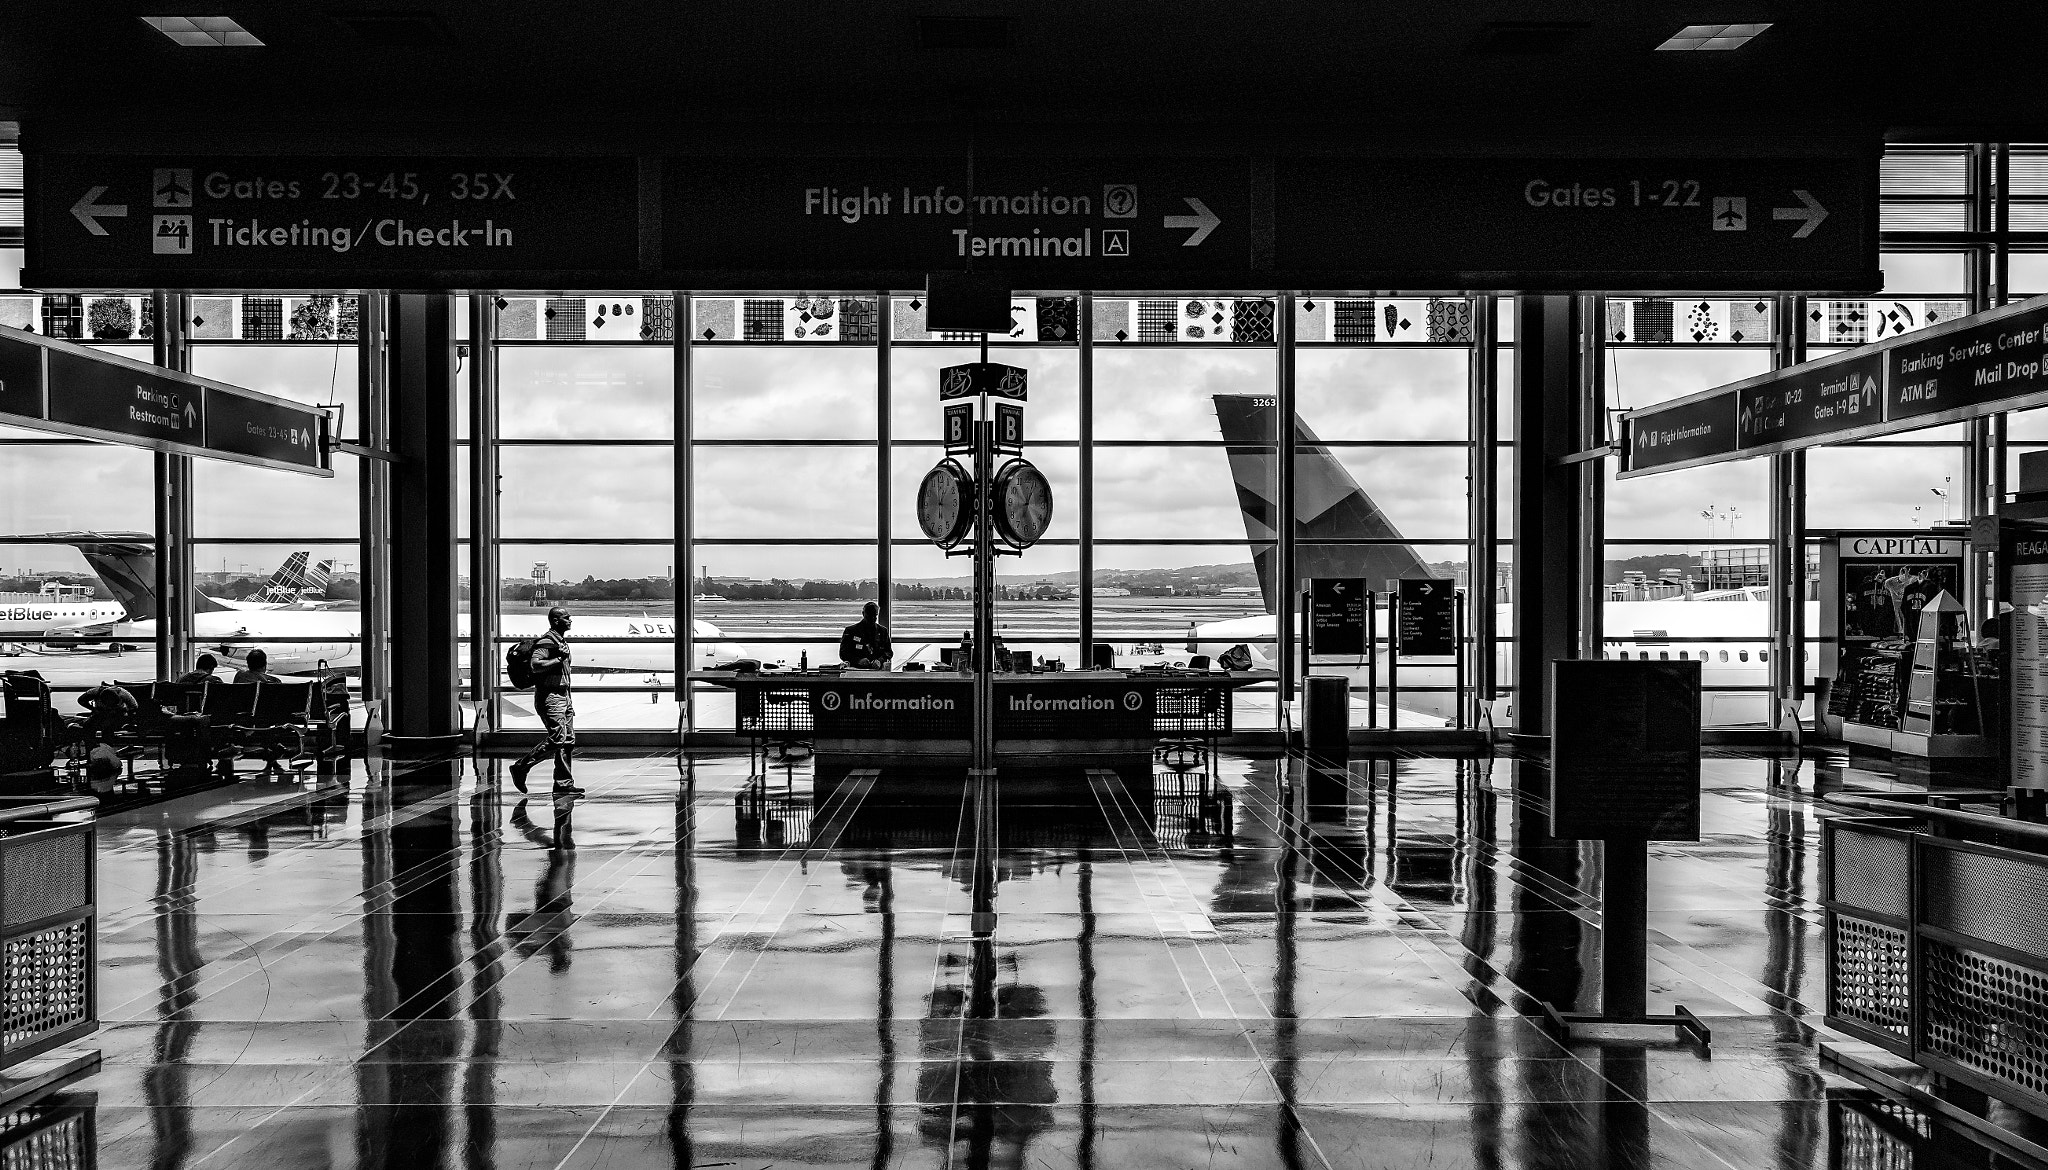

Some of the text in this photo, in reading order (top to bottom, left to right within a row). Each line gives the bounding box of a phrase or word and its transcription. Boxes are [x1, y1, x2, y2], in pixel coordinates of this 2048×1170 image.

[204, 172, 516, 205] Gates 23-45, 35X
[1525, 179, 1700, 207] Gates 1-22
[805, 186, 1091, 223] Flight Information
[208, 218, 513, 252] Ticketing/Check-In
[952, 228, 1091, 256] Terminal
[1901, 328, 2040, 375] Banking Service Center
[1974, 360, 2038, 387] Mail Drop
[137, 384, 169, 409] Parking
[1820, 377, 1848, 396] Terminal
[1900, 384, 1923, 404] ATM
[1253, 398, 1276, 407] 3263
[1814, 399, 1847, 420] Gates 1-9
[130, 405, 170, 427] Restroom
[1006, 416, 1016, 440] B
[246, 421, 267, 438] Gates
[952, 416, 962, 441] B
[1660, 422, 1712, 446] Flight Information
[1853, 538, 1948, 556] CAPITAL
[266, 584, 296, 596] jetBlue
[848, 692, 955, 710] Information
[1008, 694, 1115, 712] Information
